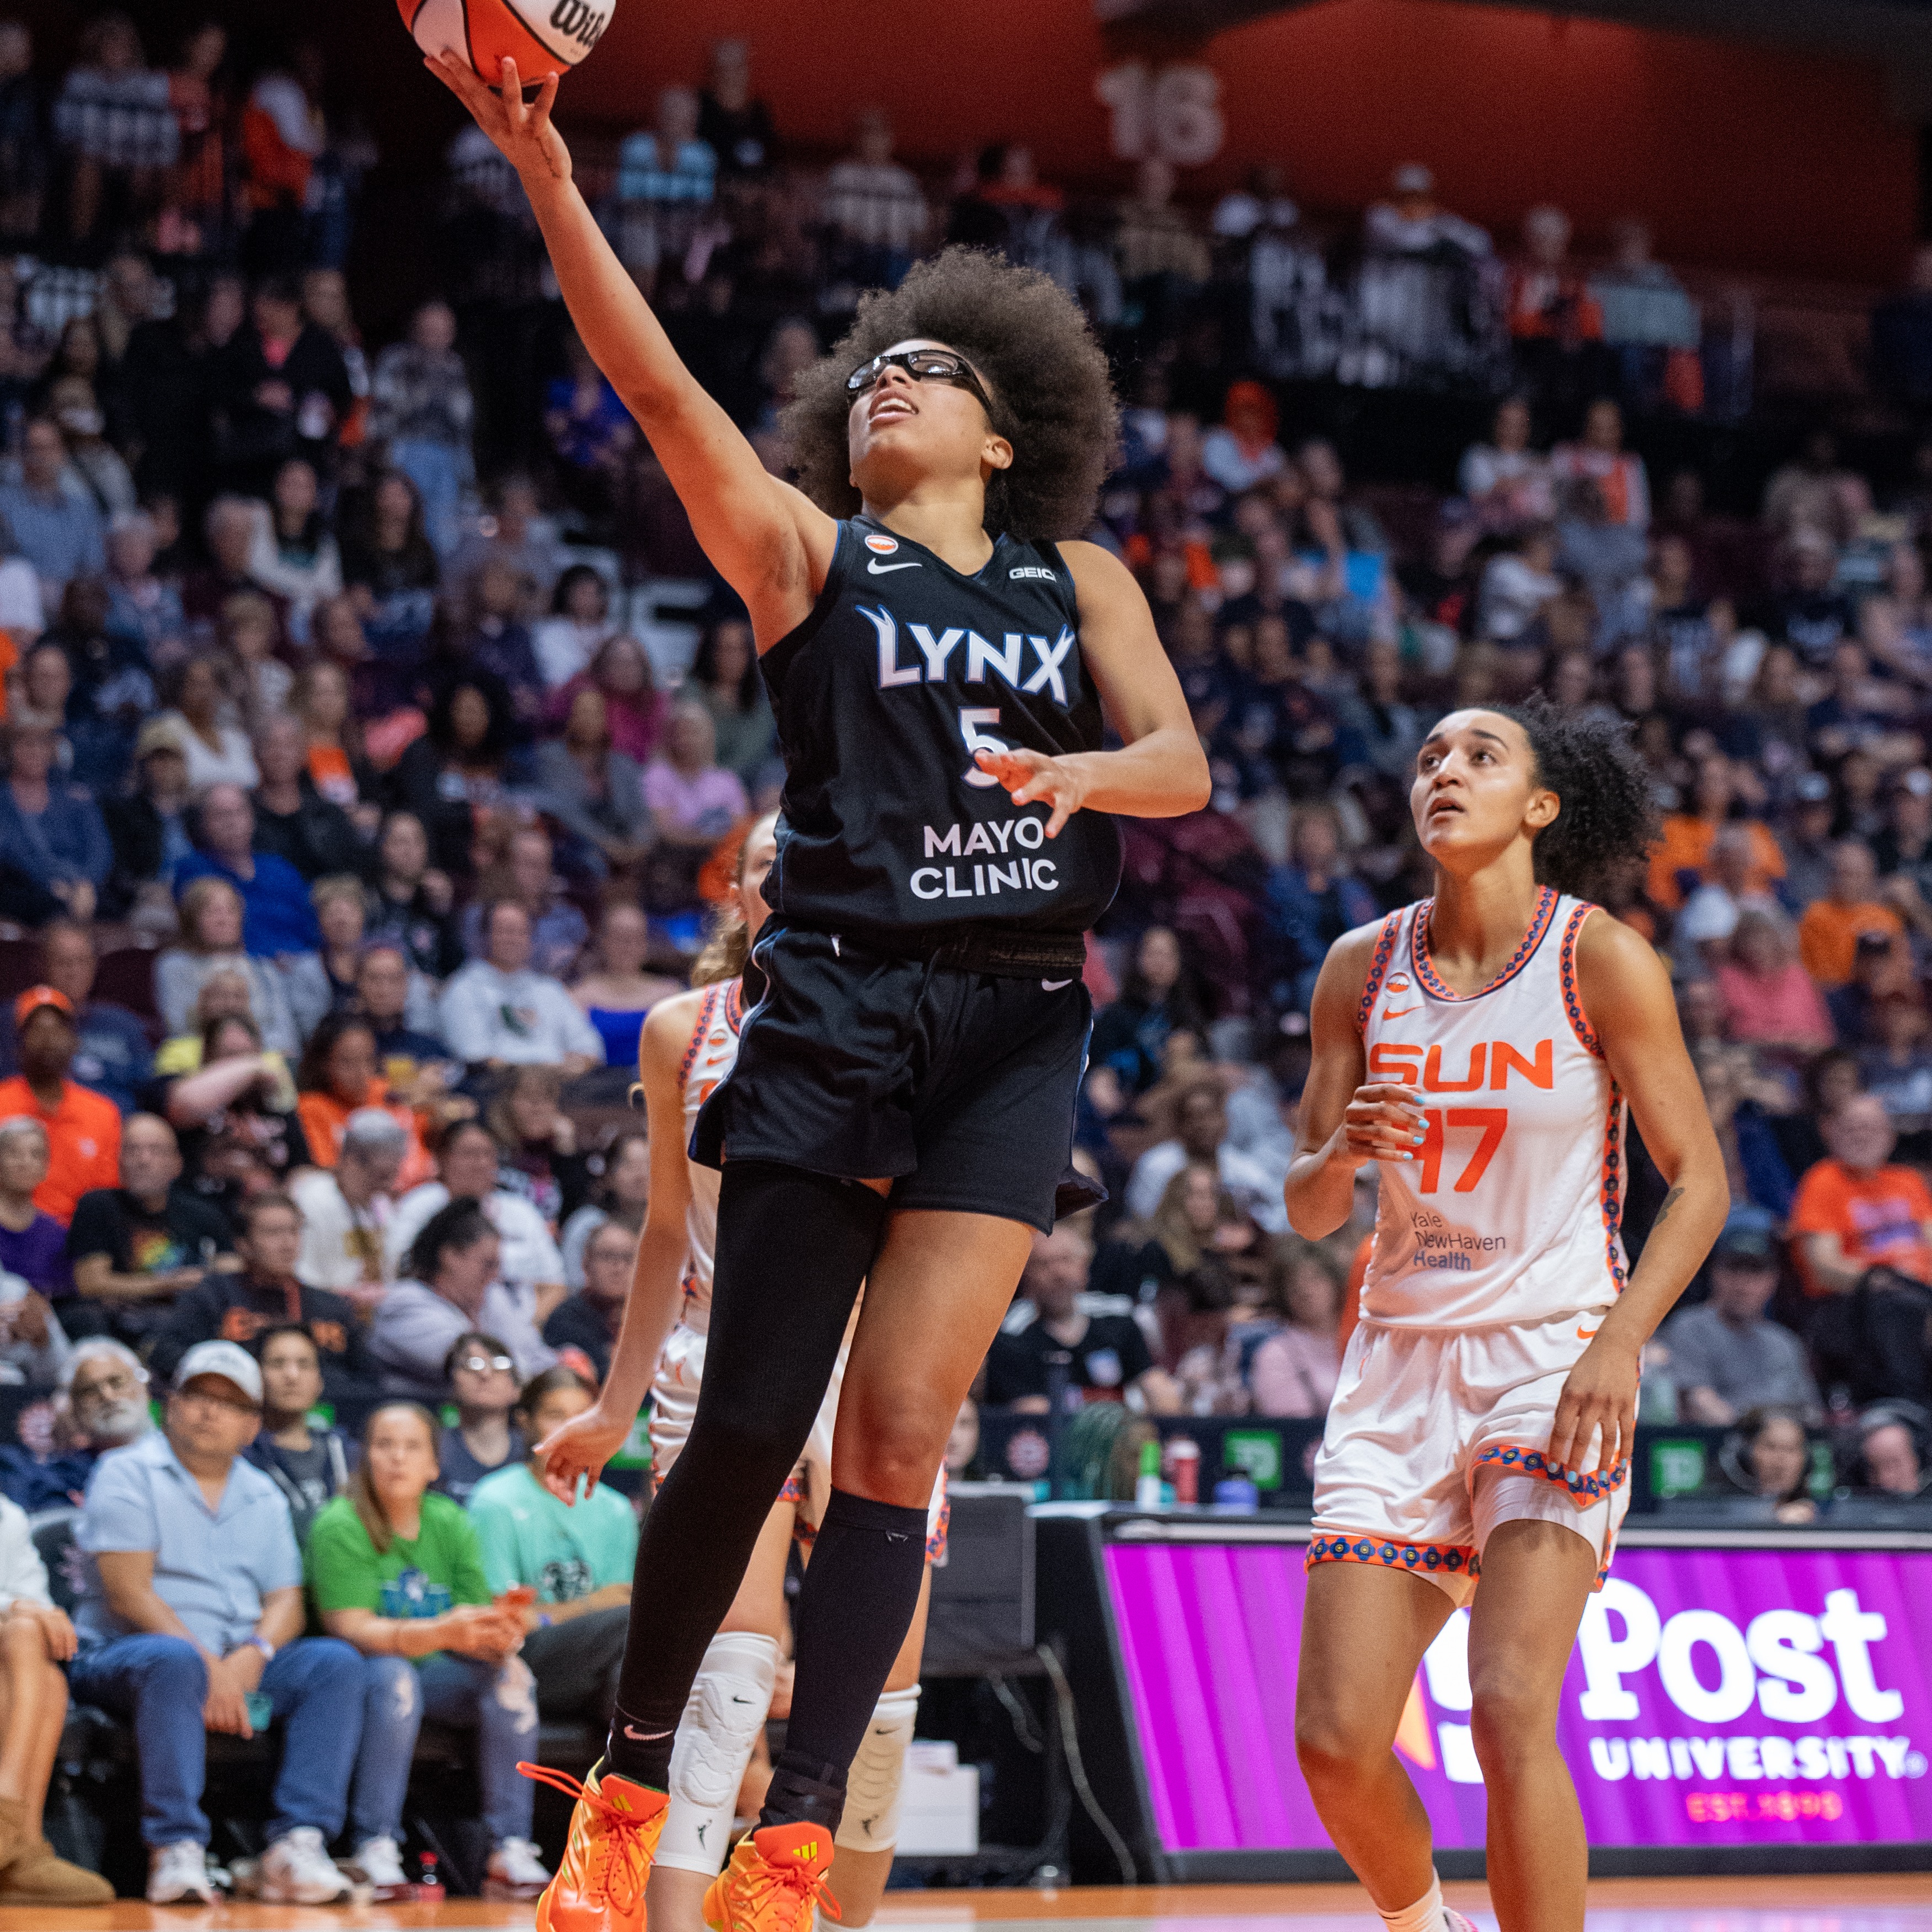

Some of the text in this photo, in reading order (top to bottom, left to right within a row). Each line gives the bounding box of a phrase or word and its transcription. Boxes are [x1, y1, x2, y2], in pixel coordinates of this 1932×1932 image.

[855, 605, 1075, 707] LYNX
[958, 706, 1010, 789] 5
[924, 816, 1044, 858] MAYO
[910, 858, 1059, 900] CLINIC
[1368, 1039, 1553, 1092] SUN
[1410, 1211, 1443, 1228] Yale
[1413, 1250, 1472, 1271] Health
[1578, 1577, 1904, 1723] Post
[1588, 1736, 1911, 1781] UNIVERSITY
